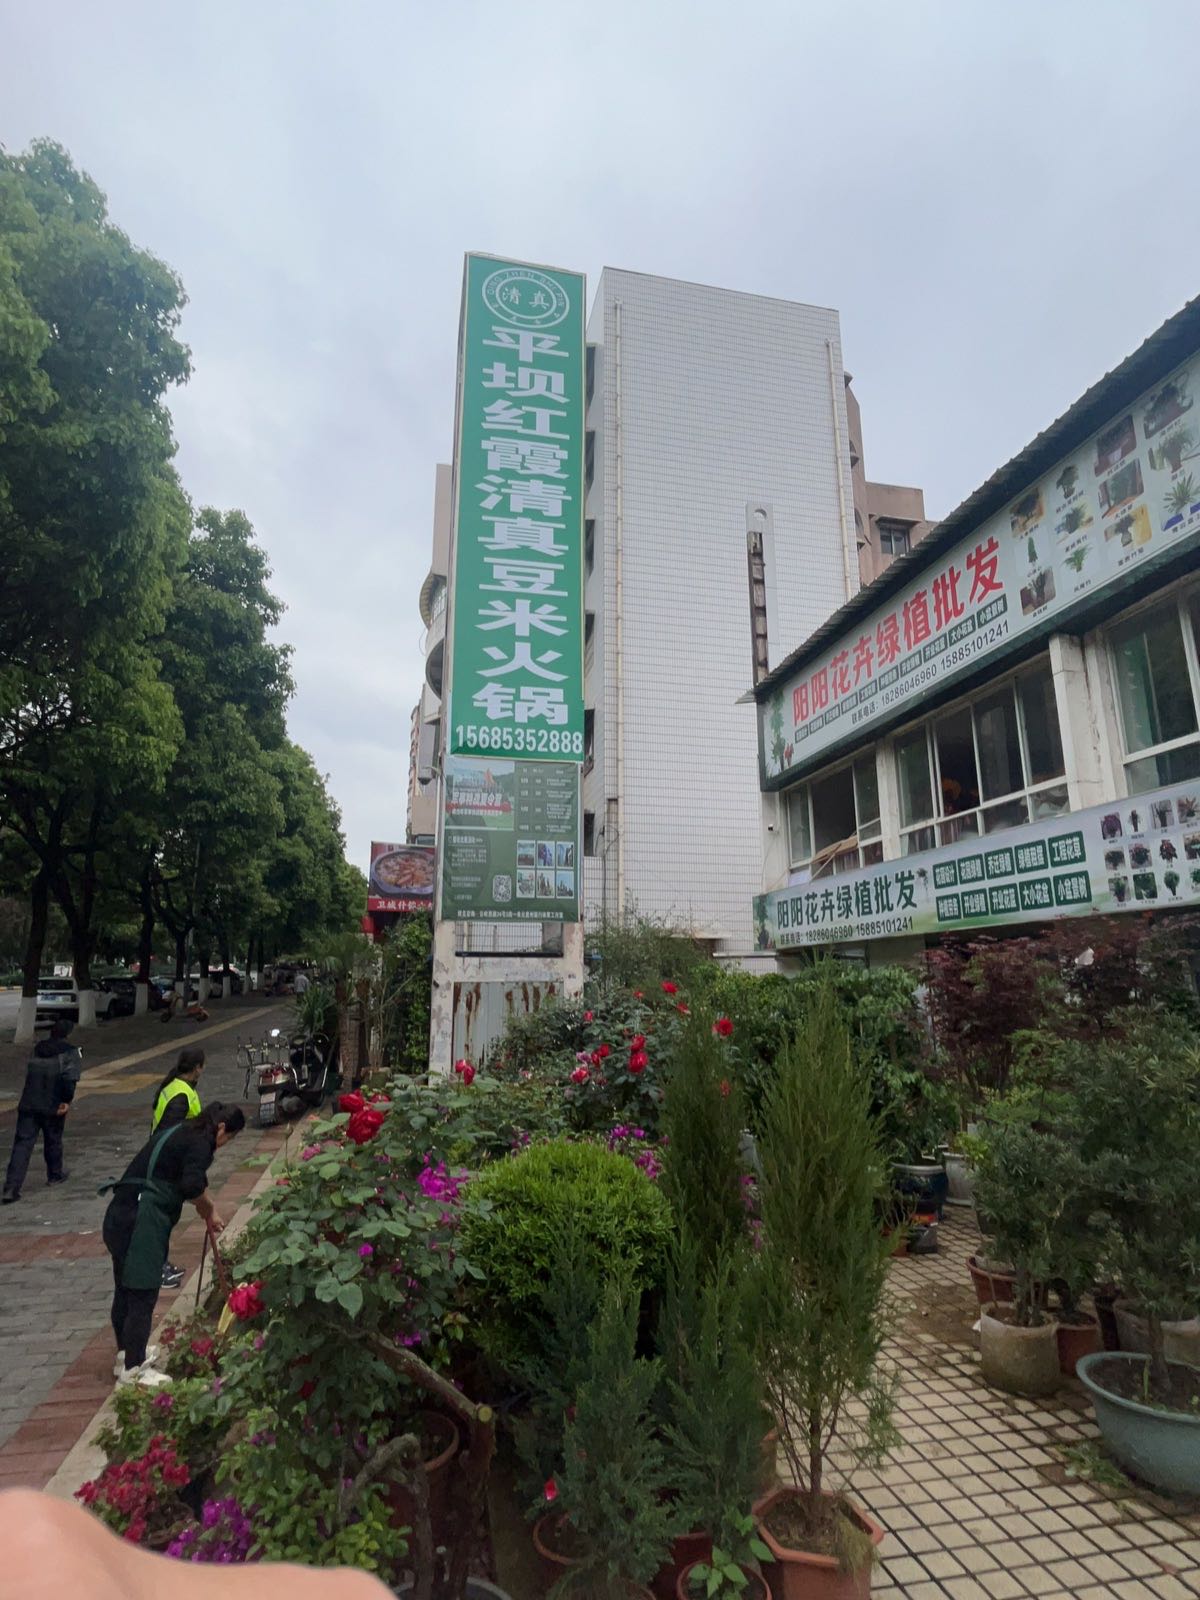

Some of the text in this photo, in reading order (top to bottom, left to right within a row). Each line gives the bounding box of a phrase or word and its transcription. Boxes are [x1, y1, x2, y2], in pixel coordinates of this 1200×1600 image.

[502, 286, 550, 310] 清真
[472, 325, 570, 725] 平坝红霞清真豆米火锅
[792, 535, 1004, 727] 阳阳花卉绿植批发
[881, 664, 937, 706] 18286046960
[940, 619, 1009, 671] 15885101241
[455, 725, 583, 755] 15685352888
[1052, 836, 1082, 862] 工程花草
[777, 870, 918, 930] 阳阳花卉绿植批发
[991, 887, 1017, 910] 开业花篮
[1023, 882, 1050, 906] 大小花盆
[1058, 875, 1089, 901] 小盆景树
[856, 916, 913, 937] 15885101241
